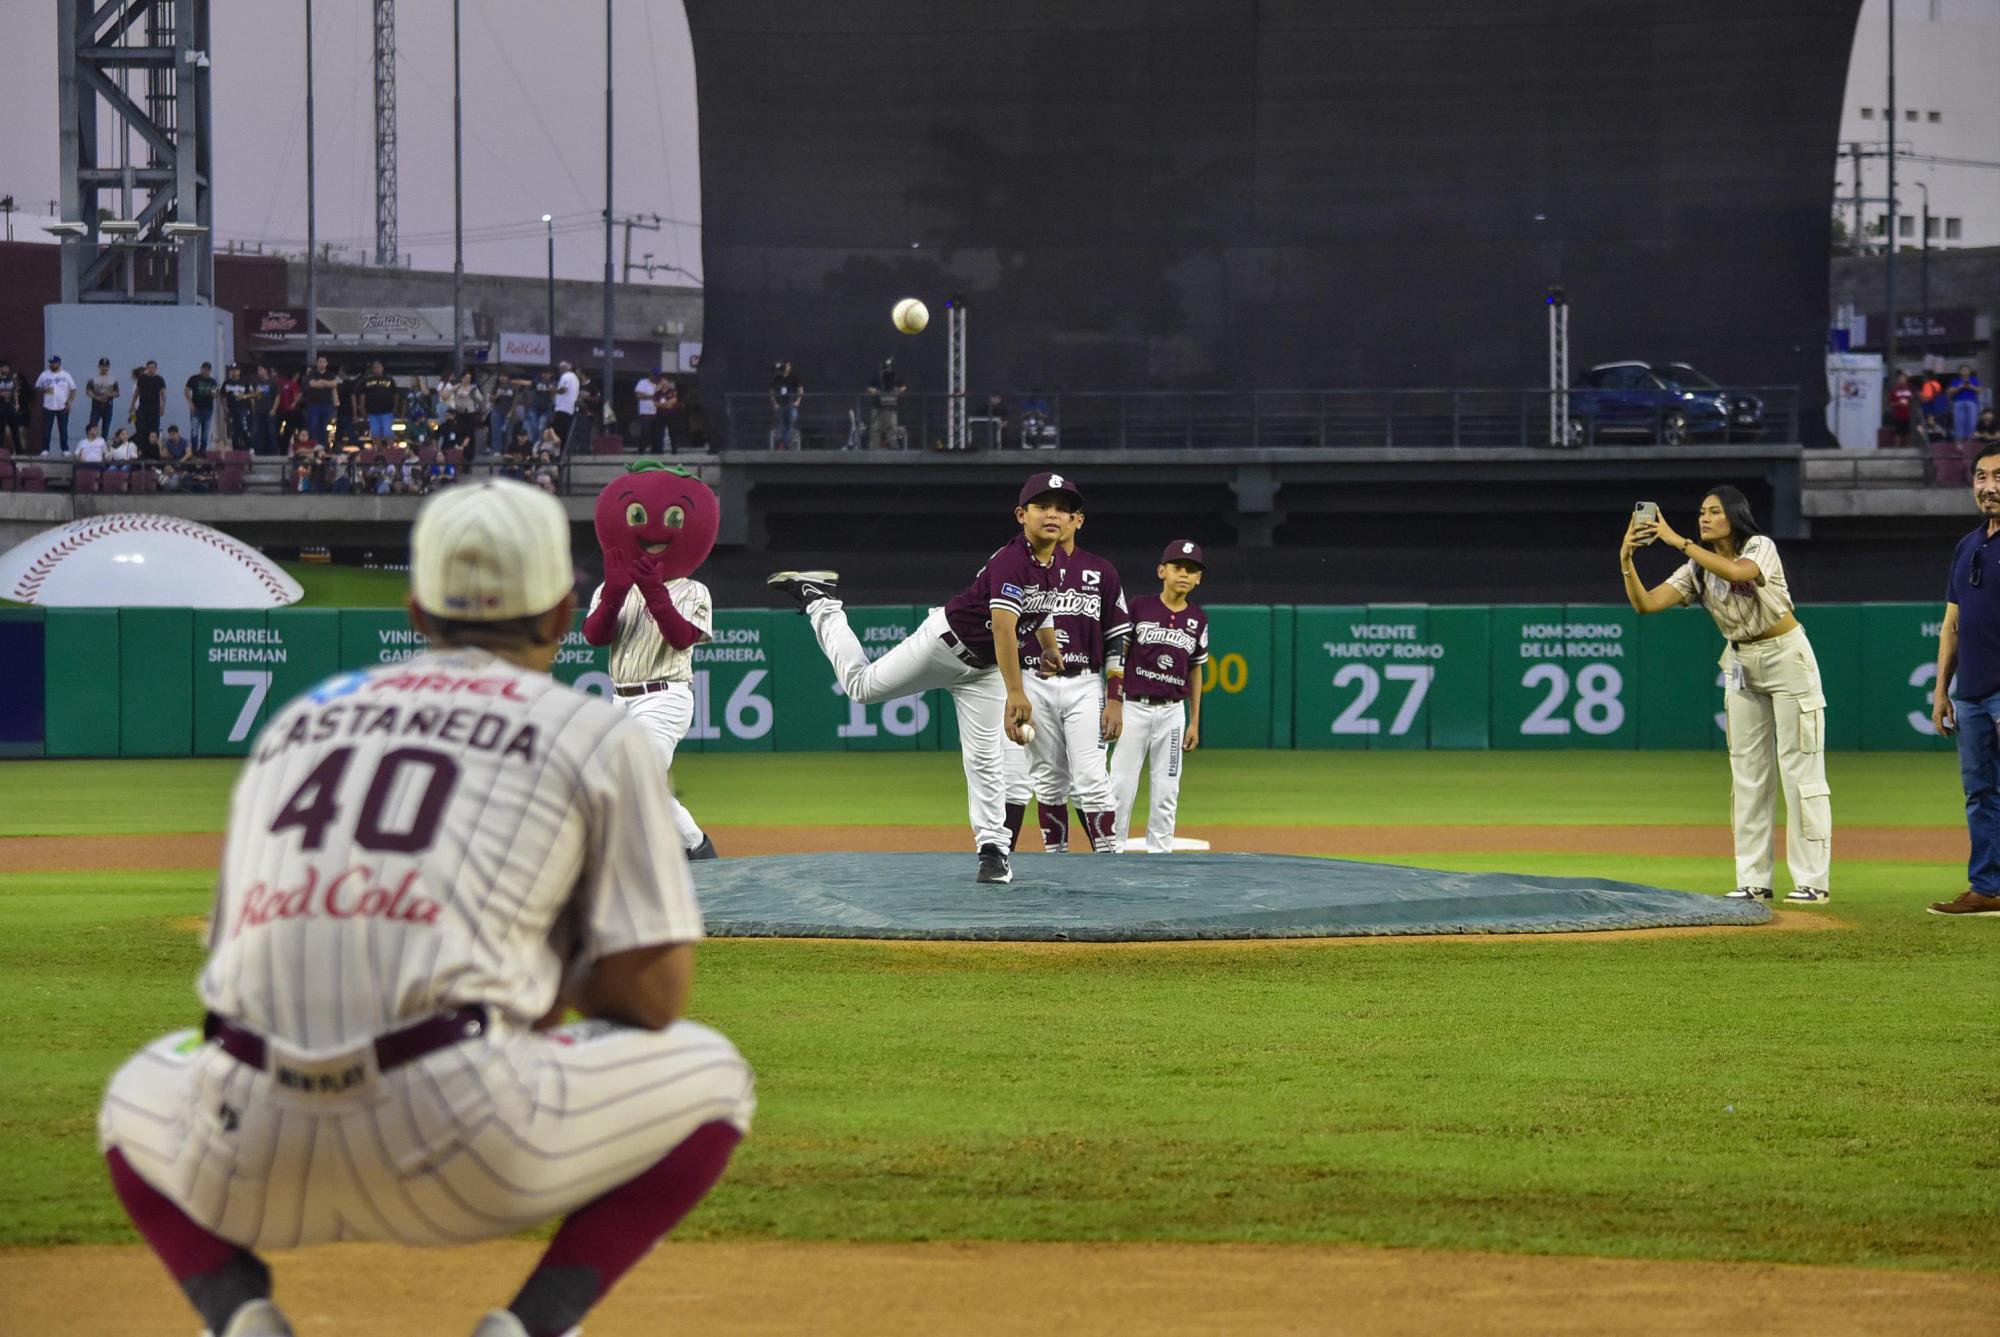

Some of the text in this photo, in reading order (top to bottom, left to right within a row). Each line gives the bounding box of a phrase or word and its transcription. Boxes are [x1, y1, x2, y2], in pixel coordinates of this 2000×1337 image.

[213, 629, 283, 644] DARRELL
[712, 629, 760, 643] ELSON
[863, 624, 907, 641] JESÚS
[1350, 625, 1417, 639] VICENTE
[1522, 625, 1622, 639] HOMOBONO
[208, 648, 287, 663] SHERMAN
[694, 648, 766, 662] BARRERA
[1393, 644, 1444, 659] ROMO
[1520, 643, 1624, 657] DE LA ROCHA
[223, 670, 273, 742] 7
[685, 669, 774, 740] 16
[1331, 663, 1435, 735] 27
[1520, 663, 1625, 735] 28
[270, 746, 458, 853] 40
[234, 865, 442, 937] Red Cola
